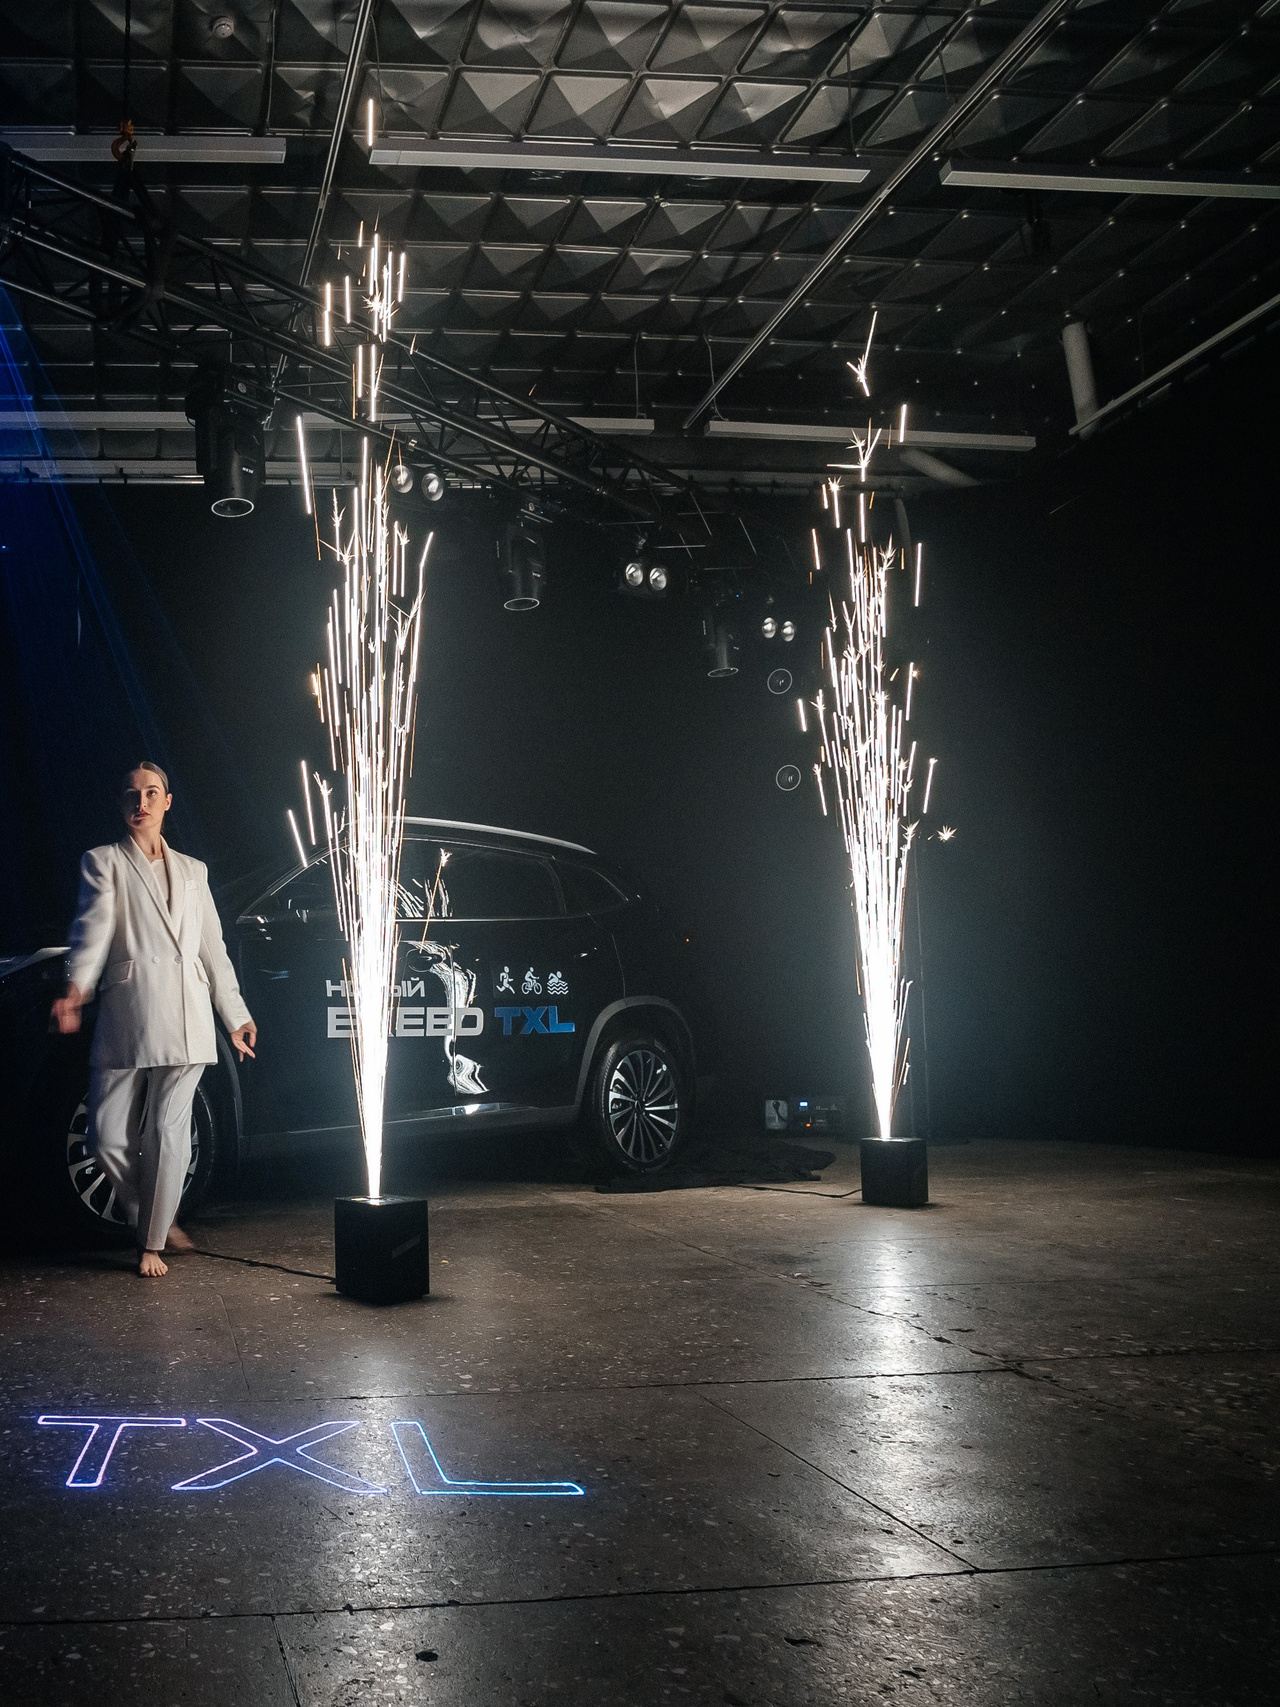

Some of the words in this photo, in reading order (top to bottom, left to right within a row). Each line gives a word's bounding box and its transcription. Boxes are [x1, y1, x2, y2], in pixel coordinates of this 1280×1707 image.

[325, 977, 425, 997] НЫЙ
[327, 1006, 484, 1038] EEED
[494, 1005, 576, 1036] TXL
[37, 1414, 586, 1495] TXL
